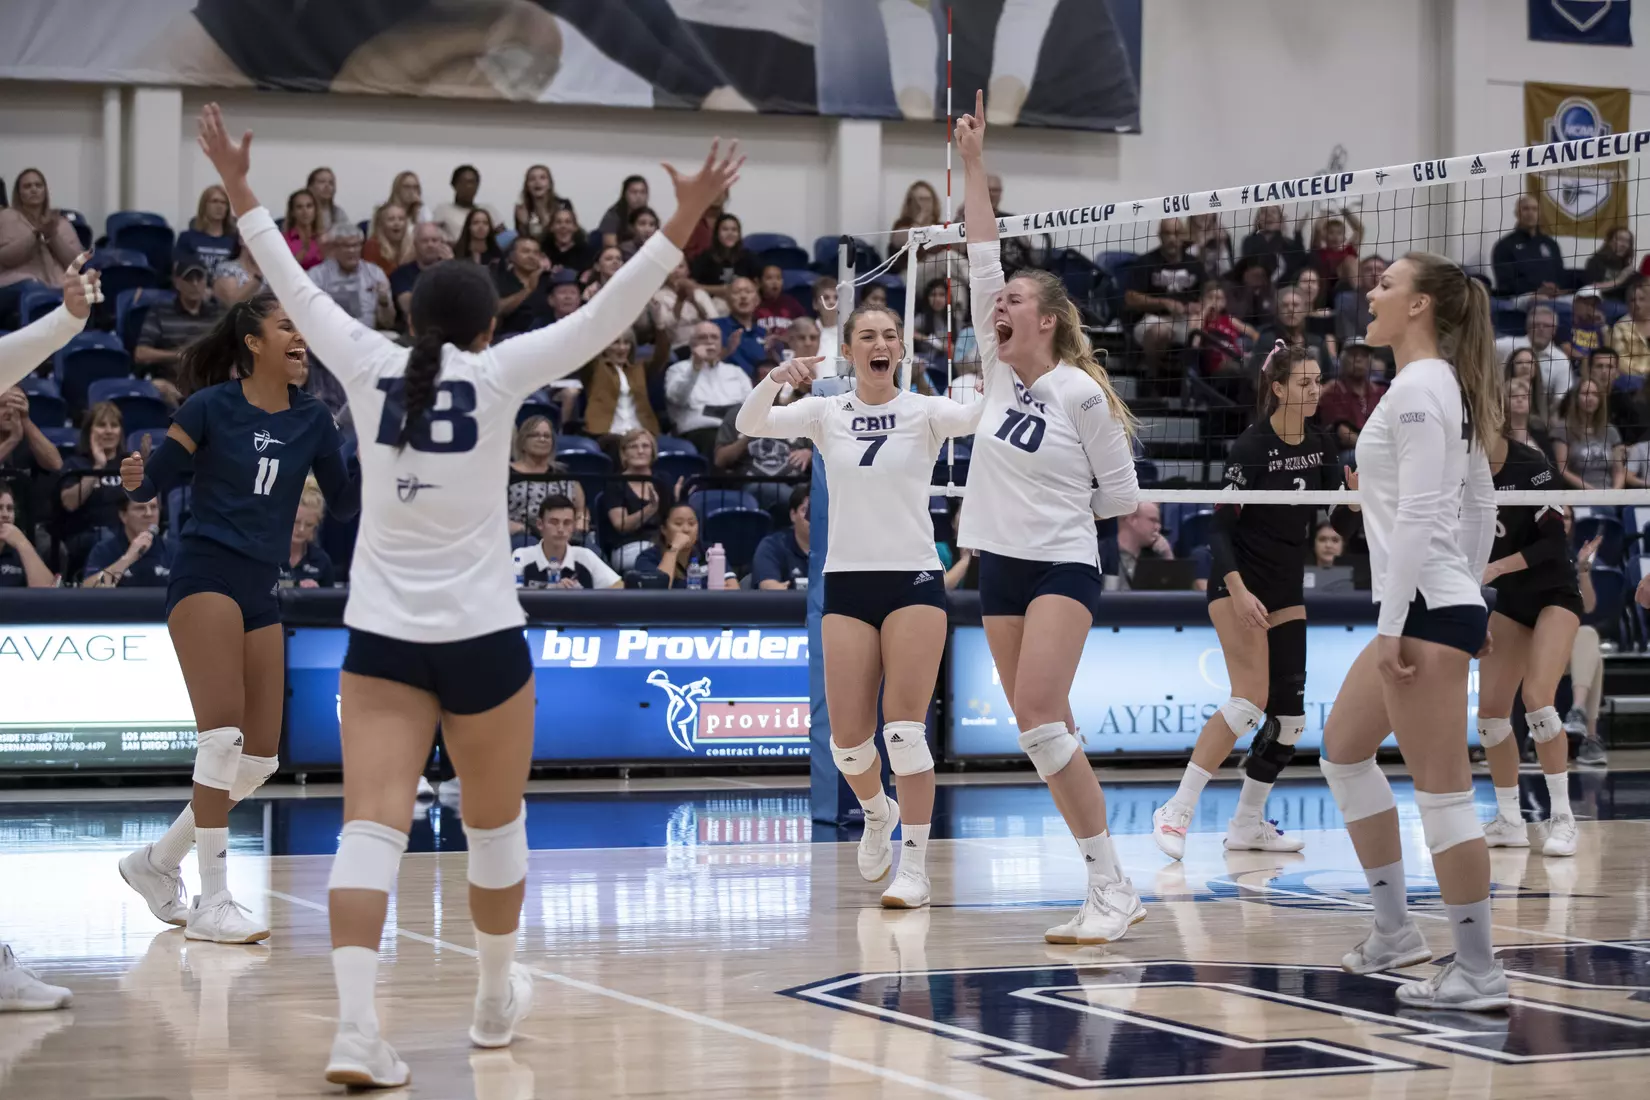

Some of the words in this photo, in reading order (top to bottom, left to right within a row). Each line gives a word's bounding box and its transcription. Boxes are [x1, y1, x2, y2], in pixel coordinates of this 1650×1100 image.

[1510, 131, 1650, 169] #LANCEUP
[1413, 160, 1447, 182] CBU
[1241, 172, 1354, 204] #LANCEUP
[1163, 195, 1190, 214] CBU
[1023, 203, 1116, 231] #LANCEUP
[1081, 393, 1103, 411] WAC
[374, 377, 479, 453] 18
[851, 413, 896, 432] CBU
[1399, 411, 1426, 423] WAC
[994, 407, 1047, 453] 10
[856, 435, 888, 466] 7
[253, 457, 280, 496] 11
[1530, 471, 1552, 486] WAC
[0, 635, 148, 661] AVAGE
[542, 630, 601, 668] by
[122, 731, 139, 741] LOS
[140, 731, 178, 741] ANGELES
[122, 741, 140, 751] SAN
[141, 741, 169, 750] DIEGO
[706, 747, 754, 757] contract
[757, 744, 784, 756] food
